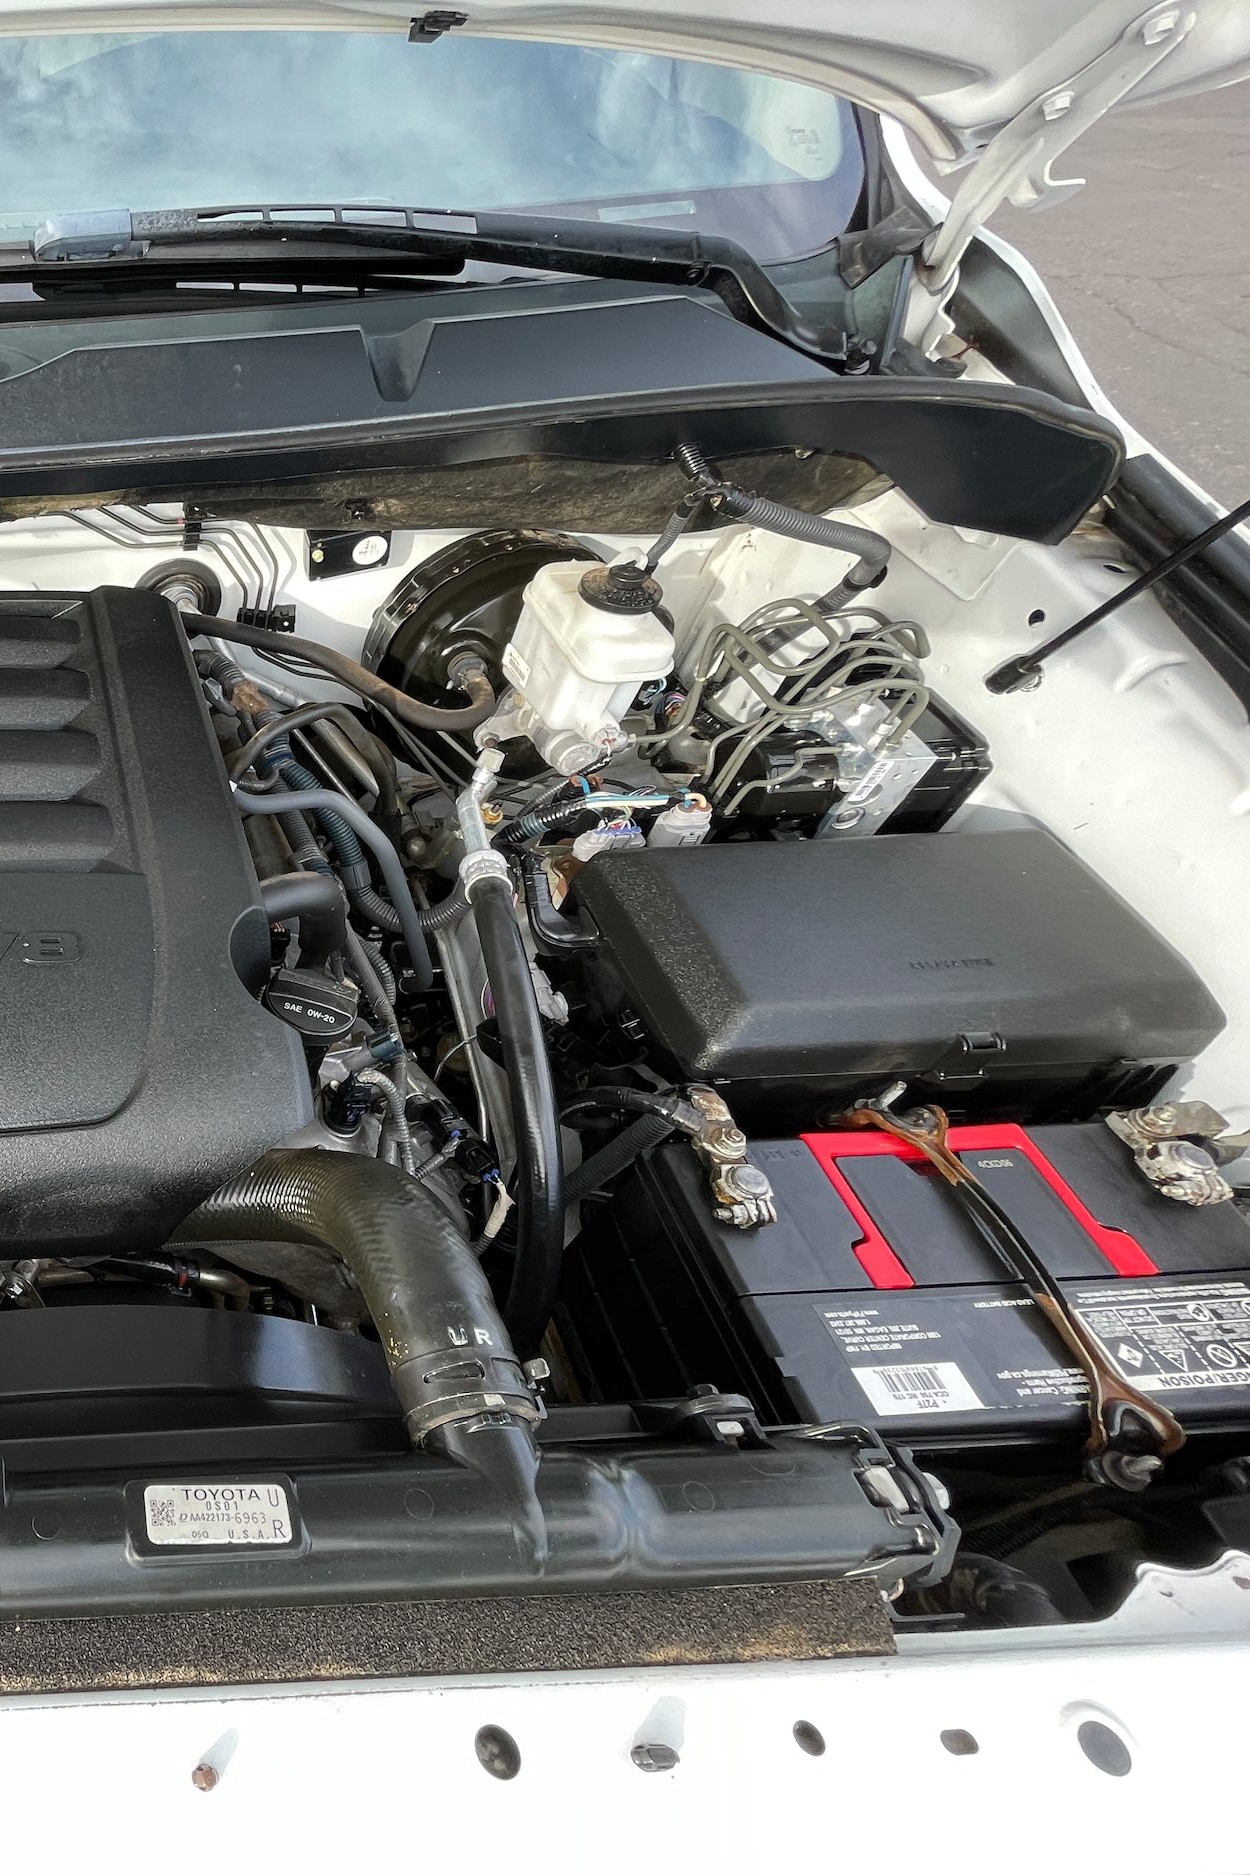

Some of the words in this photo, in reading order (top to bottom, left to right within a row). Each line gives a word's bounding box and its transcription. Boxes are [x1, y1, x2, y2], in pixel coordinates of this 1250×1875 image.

[283, 1002, 303, 1014] SAE
[307, 1009, 335, 1024] 0W-20
[933, 1390, 950, 1398] CCA
[181, 1488, 261, 1500] TOYOTA
[267, 1489, 280, 1508] U
[272, 1519, 287, 1538] R
